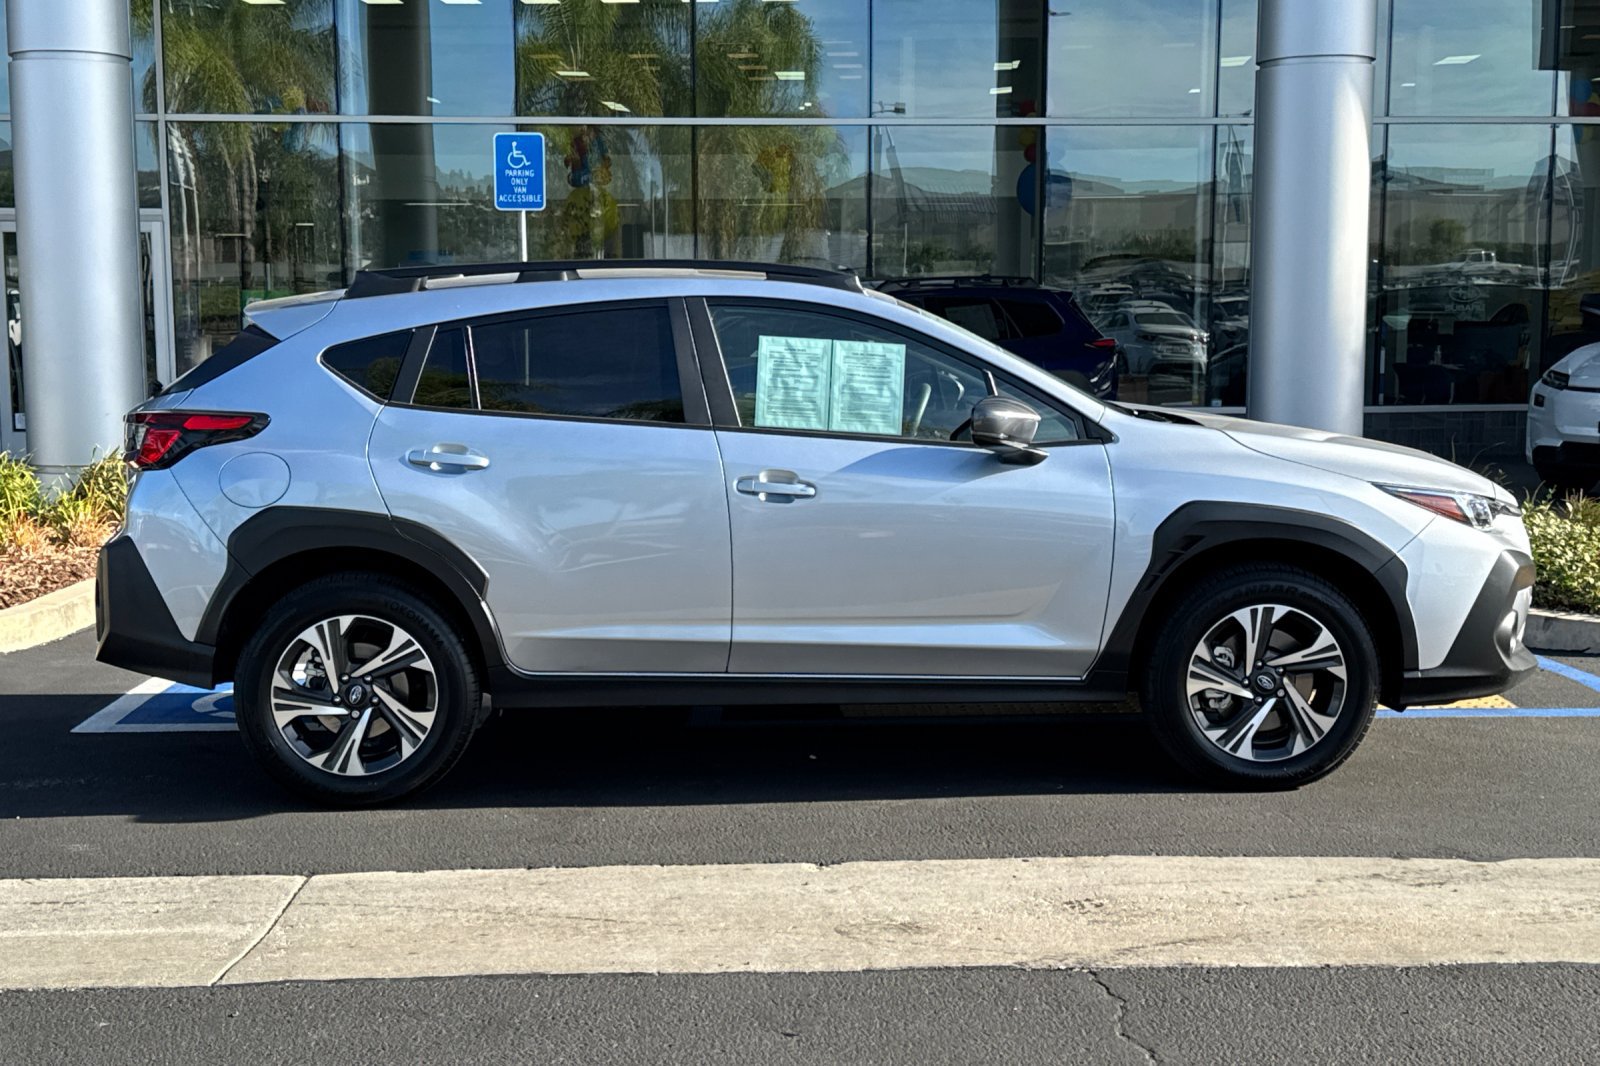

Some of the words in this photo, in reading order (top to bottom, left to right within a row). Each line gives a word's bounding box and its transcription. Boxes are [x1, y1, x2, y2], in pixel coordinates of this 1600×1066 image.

[505, 169, 535, 177] PARKING
[499, 194, 542, 202] ACCESSIBLE
[384, 601, 444, 646] YOKOHAMA
